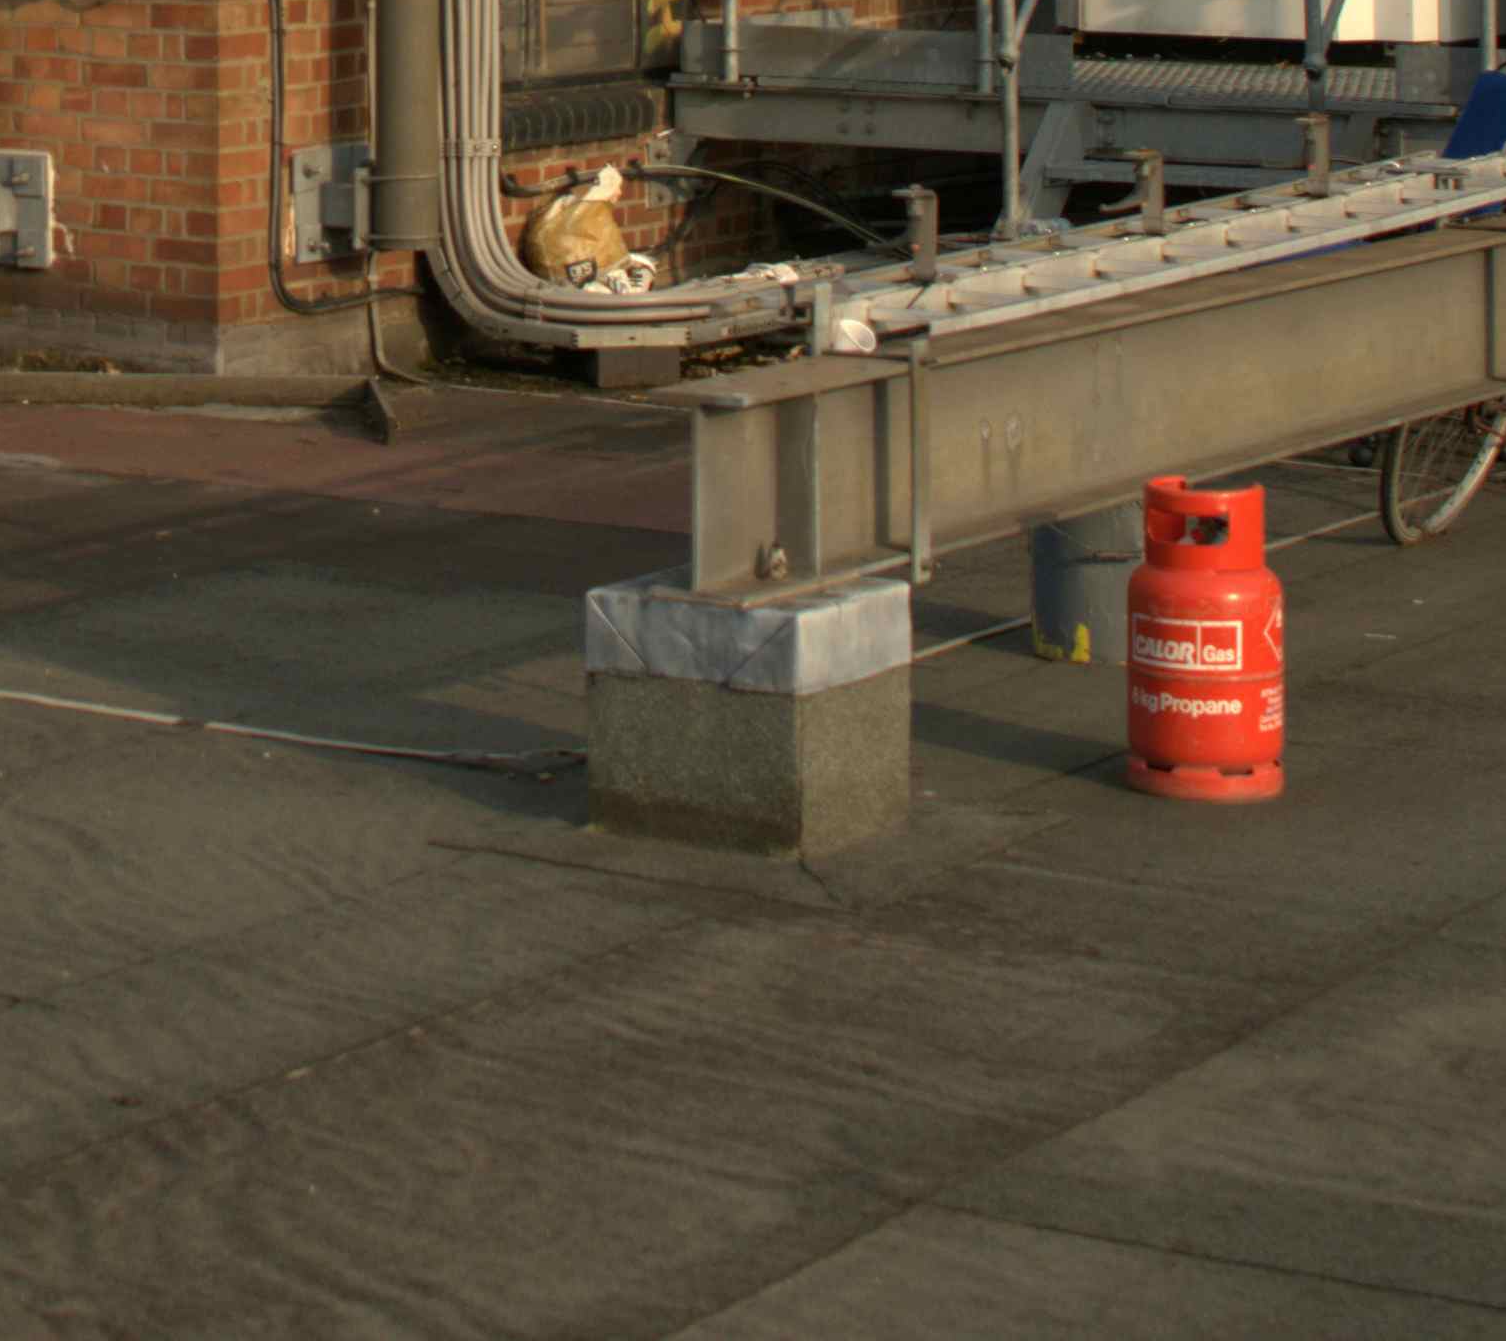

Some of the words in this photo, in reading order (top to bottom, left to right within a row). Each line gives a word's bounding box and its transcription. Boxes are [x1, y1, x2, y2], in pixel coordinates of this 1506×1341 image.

[1136, 635, 1196, 666] CALOR
[1202, 645, 1236, 664] Gas
[1160, 692, 1242, 718] Propane
